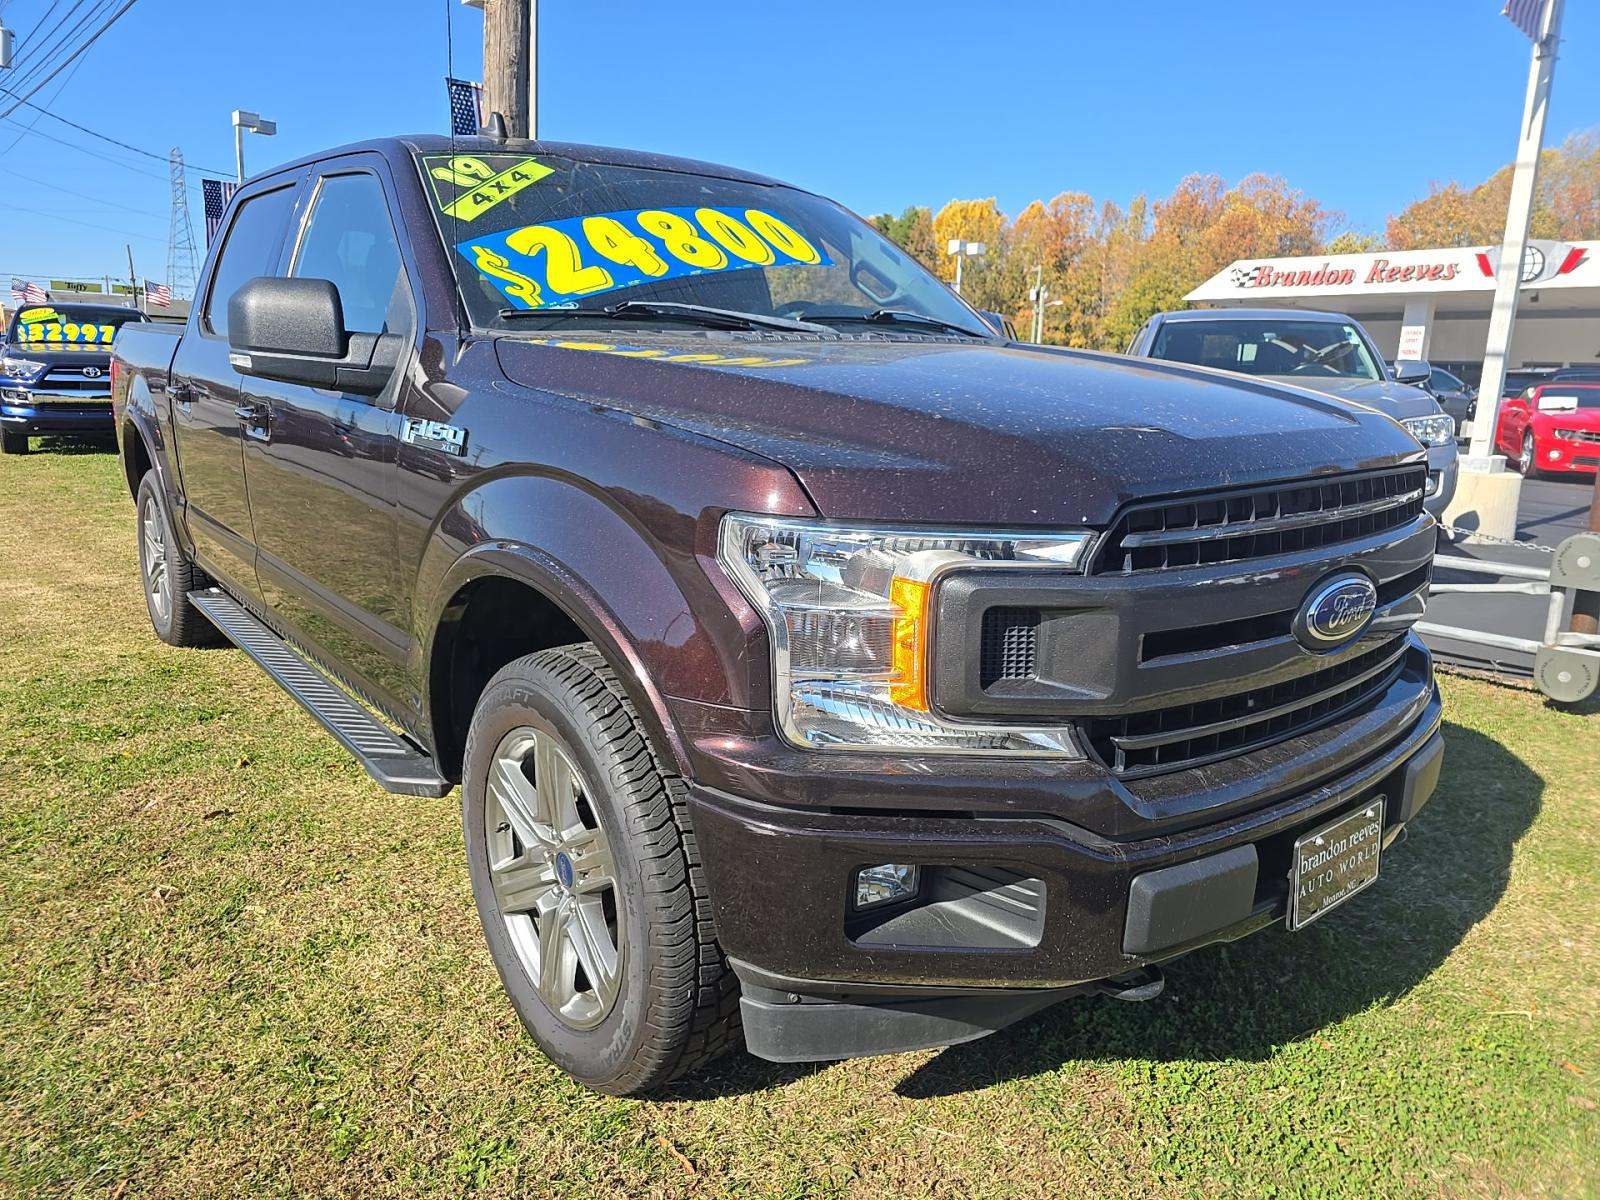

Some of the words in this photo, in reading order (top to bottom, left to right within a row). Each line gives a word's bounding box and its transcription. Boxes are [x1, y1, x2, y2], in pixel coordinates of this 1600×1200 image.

[430, 156, 497, 188] 19
[471, 207, 822, 309] $24800
[1252, 263, 1356, 289] Brandon
[1364, 259, 1461, 284] Reeves
[17, 322, 115, 342] $32997
[441, 441, 456, 453] XLT
[1328, 593, 1367, 629] Ford
[1300, 839, 1347, 875] brandon
[1349, 821, 1379, 848] reeves
[1299, 869, 1333, 899] AUTO
[1340, 842, 1378, 875] WORLD
